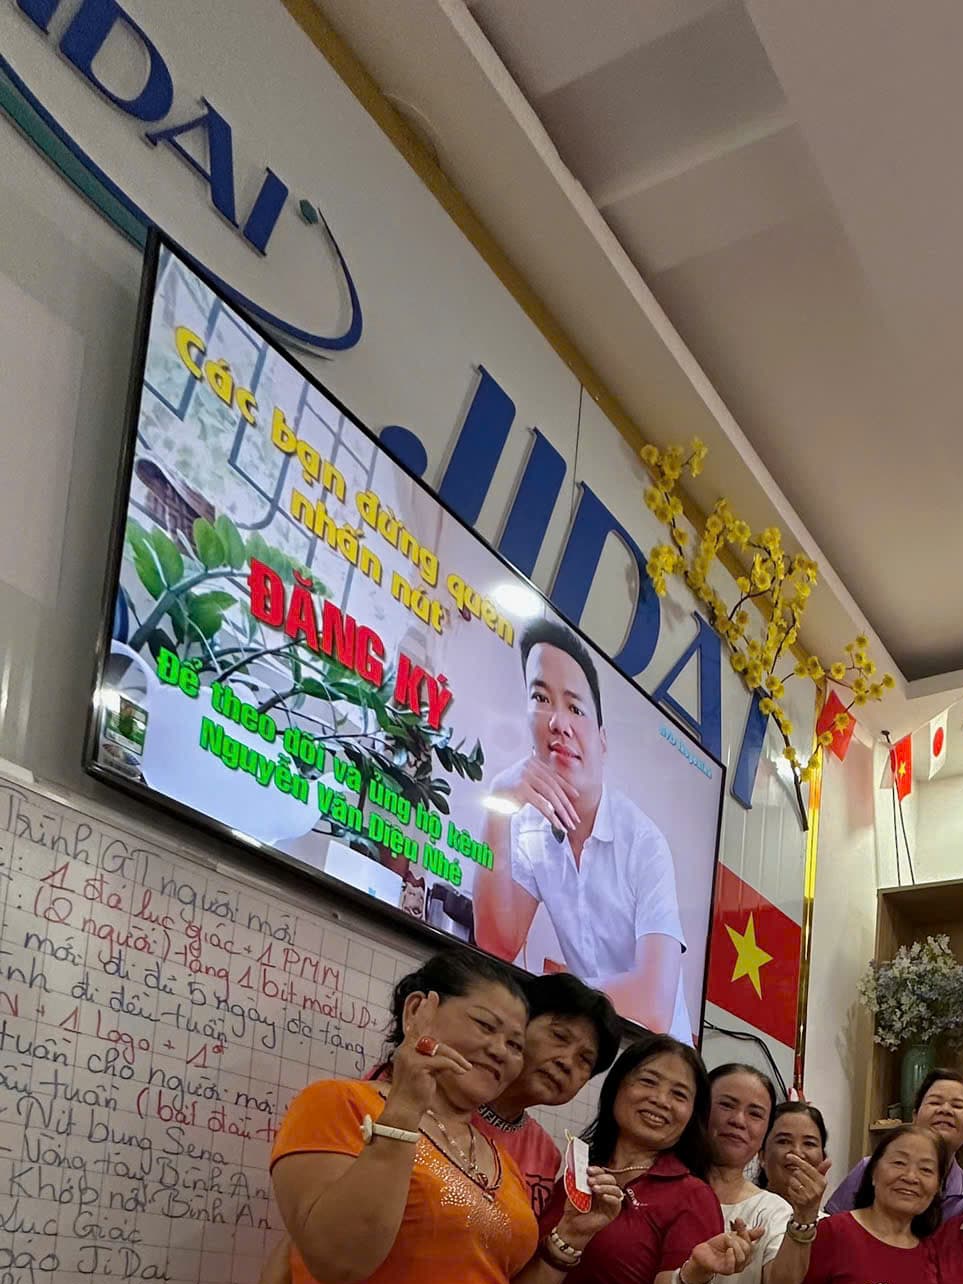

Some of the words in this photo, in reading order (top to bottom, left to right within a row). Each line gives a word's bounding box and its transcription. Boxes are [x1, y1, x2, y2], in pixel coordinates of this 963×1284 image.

[175, 325, 257, 427] Các
[272, 406, 346, 501] bạn
[355, 488, 439, 588] đừng
[446, 573, 515, 647] quên
[290, 487, 383, 586] nhấn
[390, 570, 444, 634] nút
[247, 556, 386, 688] ĐĂNG
[393, 651, 454, 731] KÝ
[156, 647, 203, 698] Để
[210, 680, 277, 743] theo
[283, 727, 325, 781] dõi
[332, 757, 364, 793] và
[369, 772, 412, 828] ủng
[415, 800, 443, 842] hộ
[447, 821, 495, 871] kênh
[199, 717, 310, 804] Nguyễn
[368, 812, 420, 865] Diệu
[422, 844, 463, 887] Nhé
